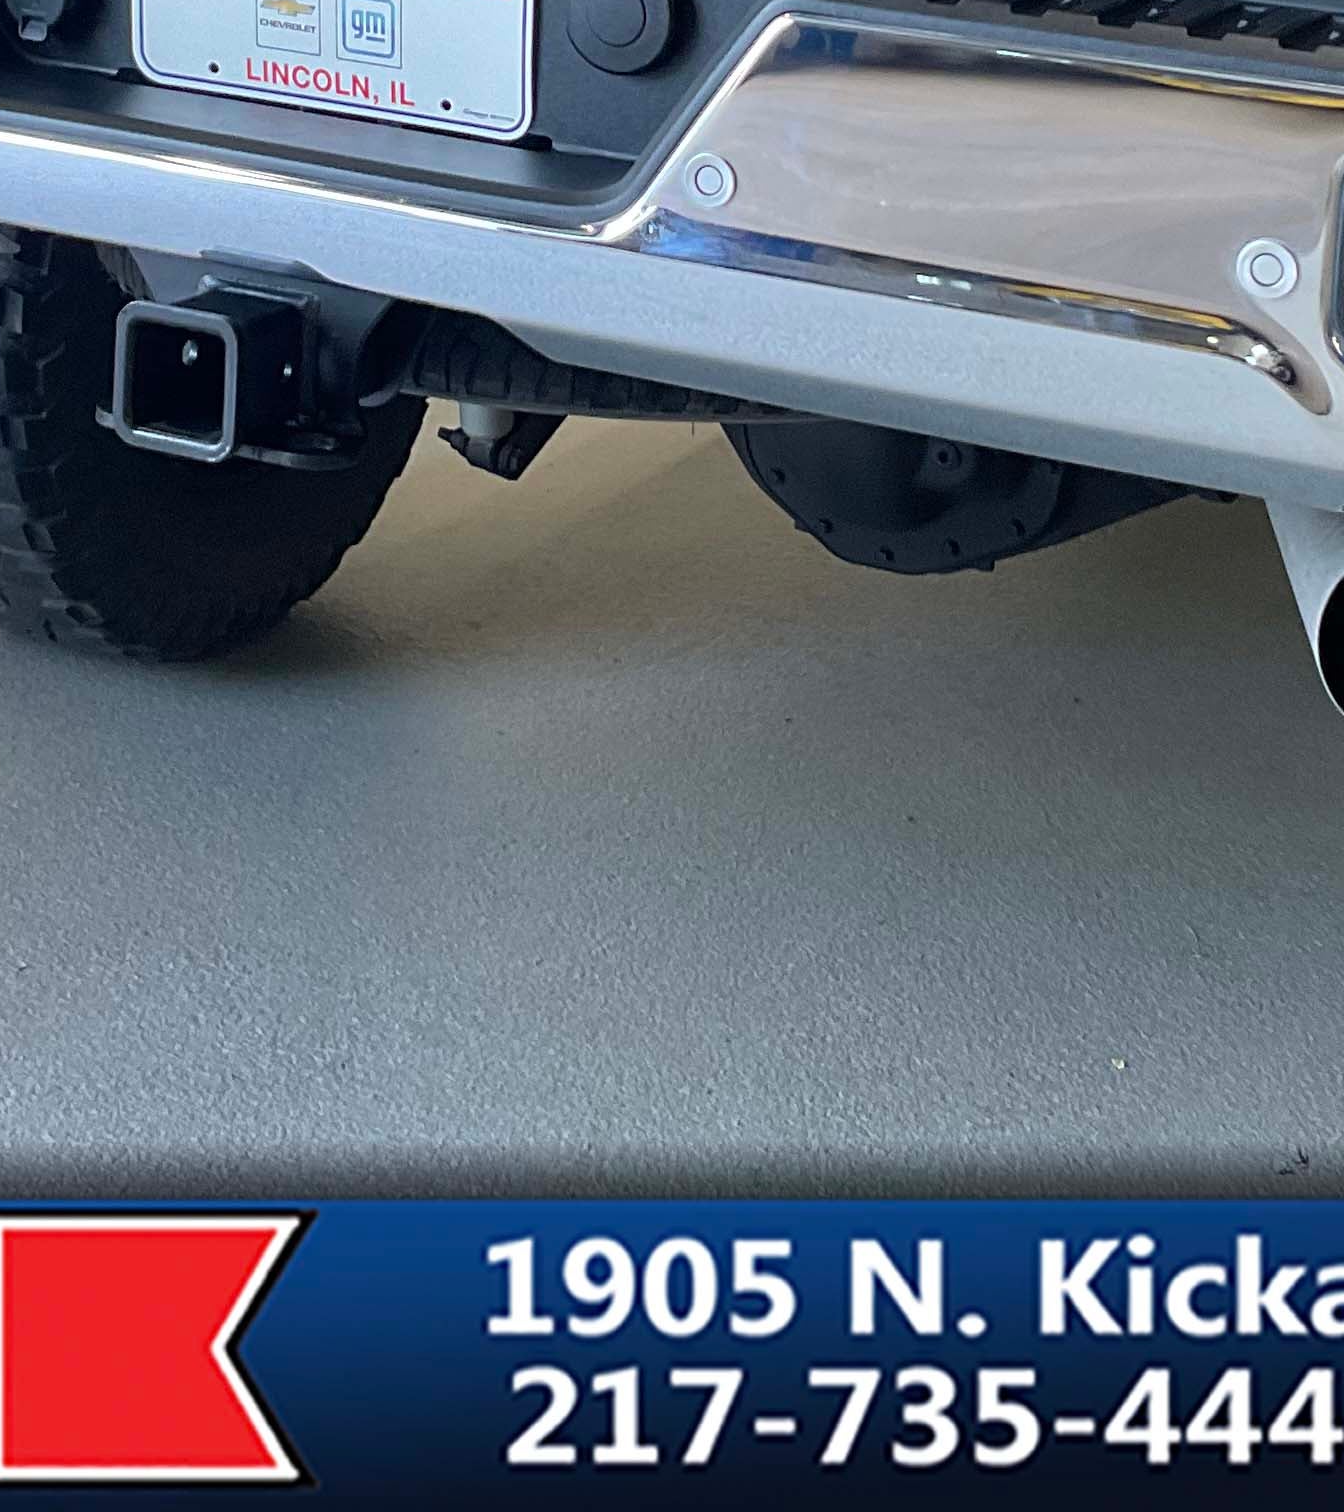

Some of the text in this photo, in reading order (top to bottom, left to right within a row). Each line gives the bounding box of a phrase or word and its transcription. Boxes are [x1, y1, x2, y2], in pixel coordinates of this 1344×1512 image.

[259, 18, 317, 35] CHEVROLET
[351, 8, 386, 39] gm
[245, 56, 416, 107] LINCOLN, IL
